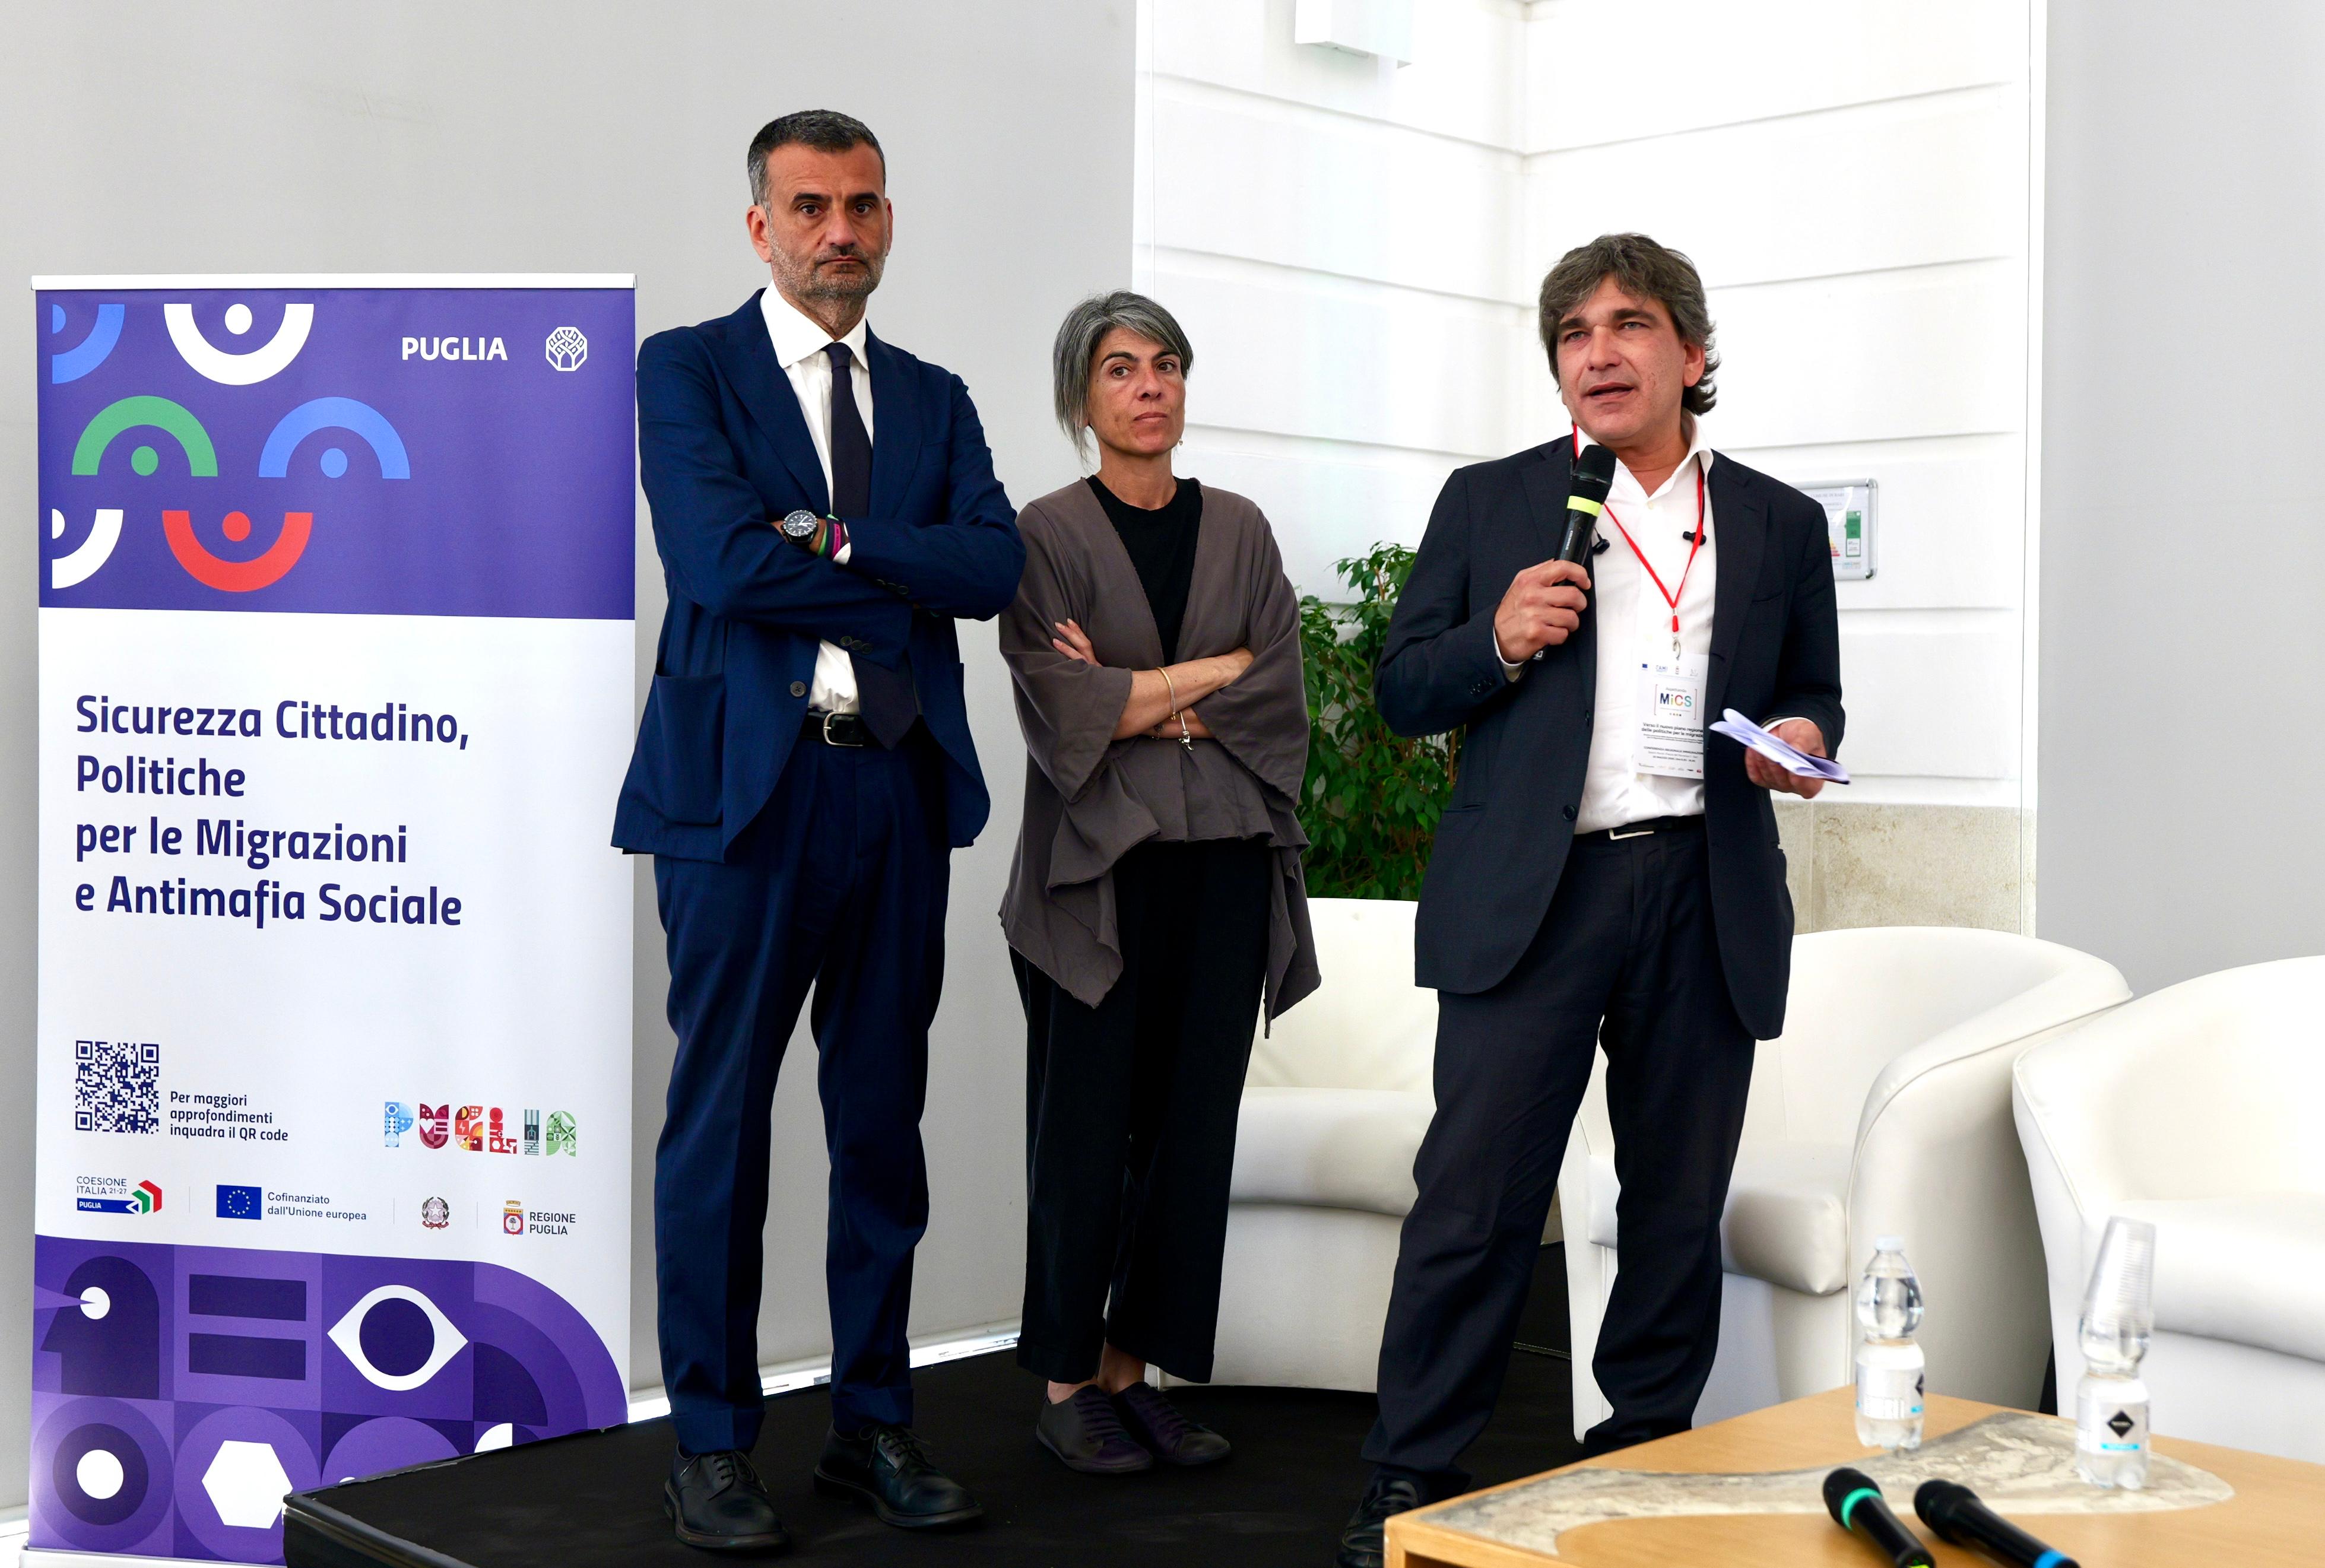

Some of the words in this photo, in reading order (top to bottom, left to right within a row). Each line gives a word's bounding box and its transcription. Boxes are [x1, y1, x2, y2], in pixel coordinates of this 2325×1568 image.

[402, 337, 507, 360] PUGLIA
[1660, 693, 1692, 707] MiCS
[77, 696, 261, 737] Sicurezza
[277, 700, 468, 750] Cittadino,
[78, 755, 245, 796] Politiche
[77, 824, 136, 862] per
[151, 817, 182, 855] le
[197, 819, 406, 869] Migrazioni
[76, 884, 94, 911] e
[107, 876, 304, 929] Antimafia
[319, 884, 461, 925] Sociale
[171, 1091, 190, 1103] Per
[195, 1094, 246, 1107] maggiori
[170, 1109, 272, 1123] approfondimenti
[171, 1124, 224, 1139] inquadra
[229, 1127, 235, 1138] il
[240, 1128, 256, 1141] QR
[261, 1129, 288, 1141] code
[385, 1102, 576, 1157] PUGLIA
[77, 1176, 127, 1186] COESIONE
[77, 1186, 107, 1195] ITALIA
[268, 1192, 329, 1204] Cofinanziato
[268, 1206, 322, 1217] dall'Unione
[326, 1212, 366, 1221] europea
[530, 1212, 575, 1223] REGIONE
[530, 1224, 567, 1234] PUGLIA
